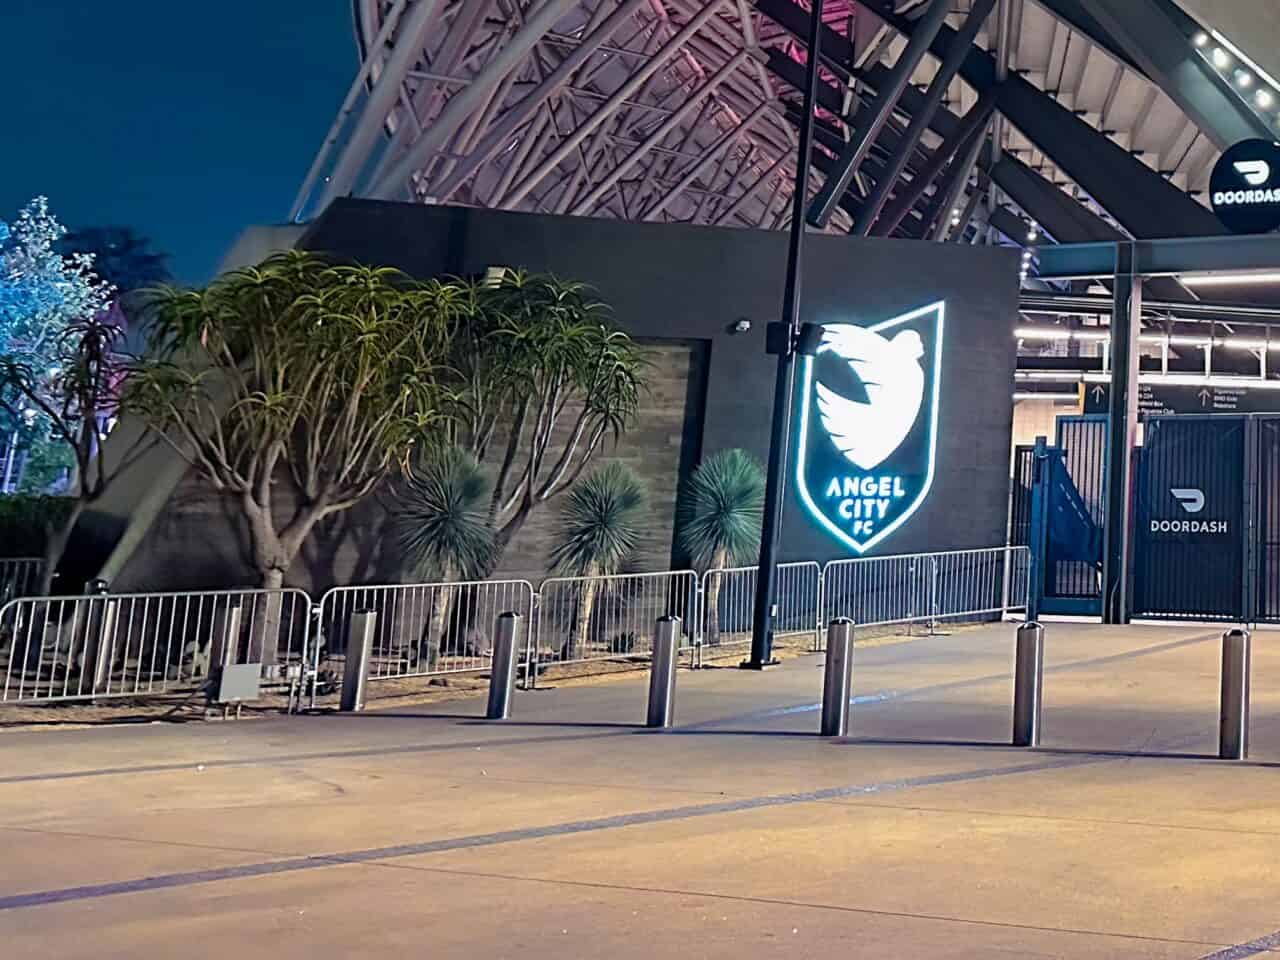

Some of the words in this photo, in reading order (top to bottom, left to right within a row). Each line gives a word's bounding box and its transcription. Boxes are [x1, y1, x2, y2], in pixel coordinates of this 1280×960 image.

[826, 476, 906, 497] ANGEL
[838, 499, 890, 519] CITY
[853, 520, 874, 535] FC
[1150, 520, 1228, 533] DOORDASH
